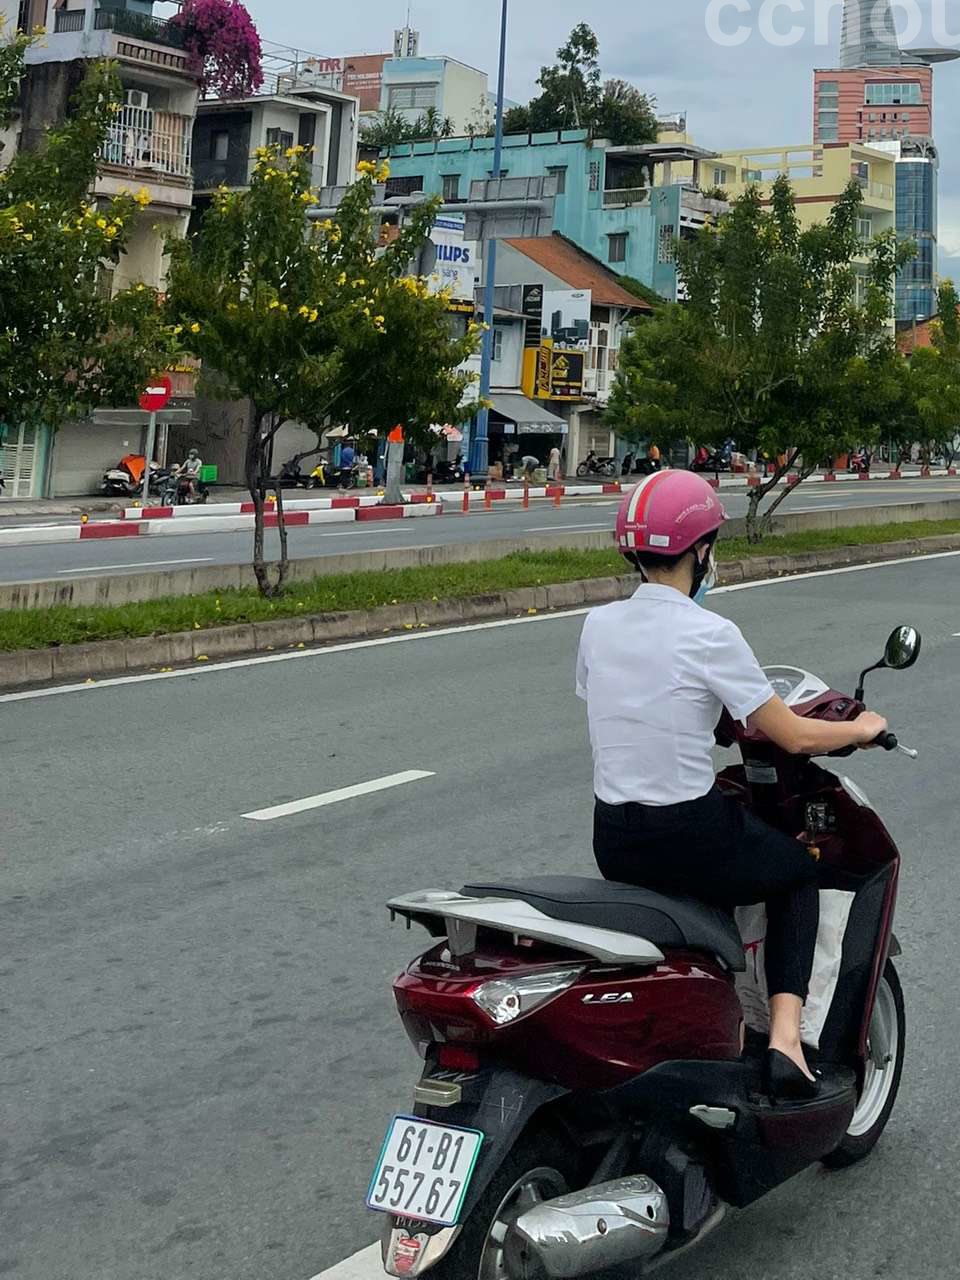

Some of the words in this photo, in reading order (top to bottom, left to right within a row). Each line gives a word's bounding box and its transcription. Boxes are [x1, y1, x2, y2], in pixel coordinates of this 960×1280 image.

[434, 245, 470, 263] ILIPS
[396, 1126, 465, 1174] 61-B1
[374, 1165, 461, 1218] 557.67
